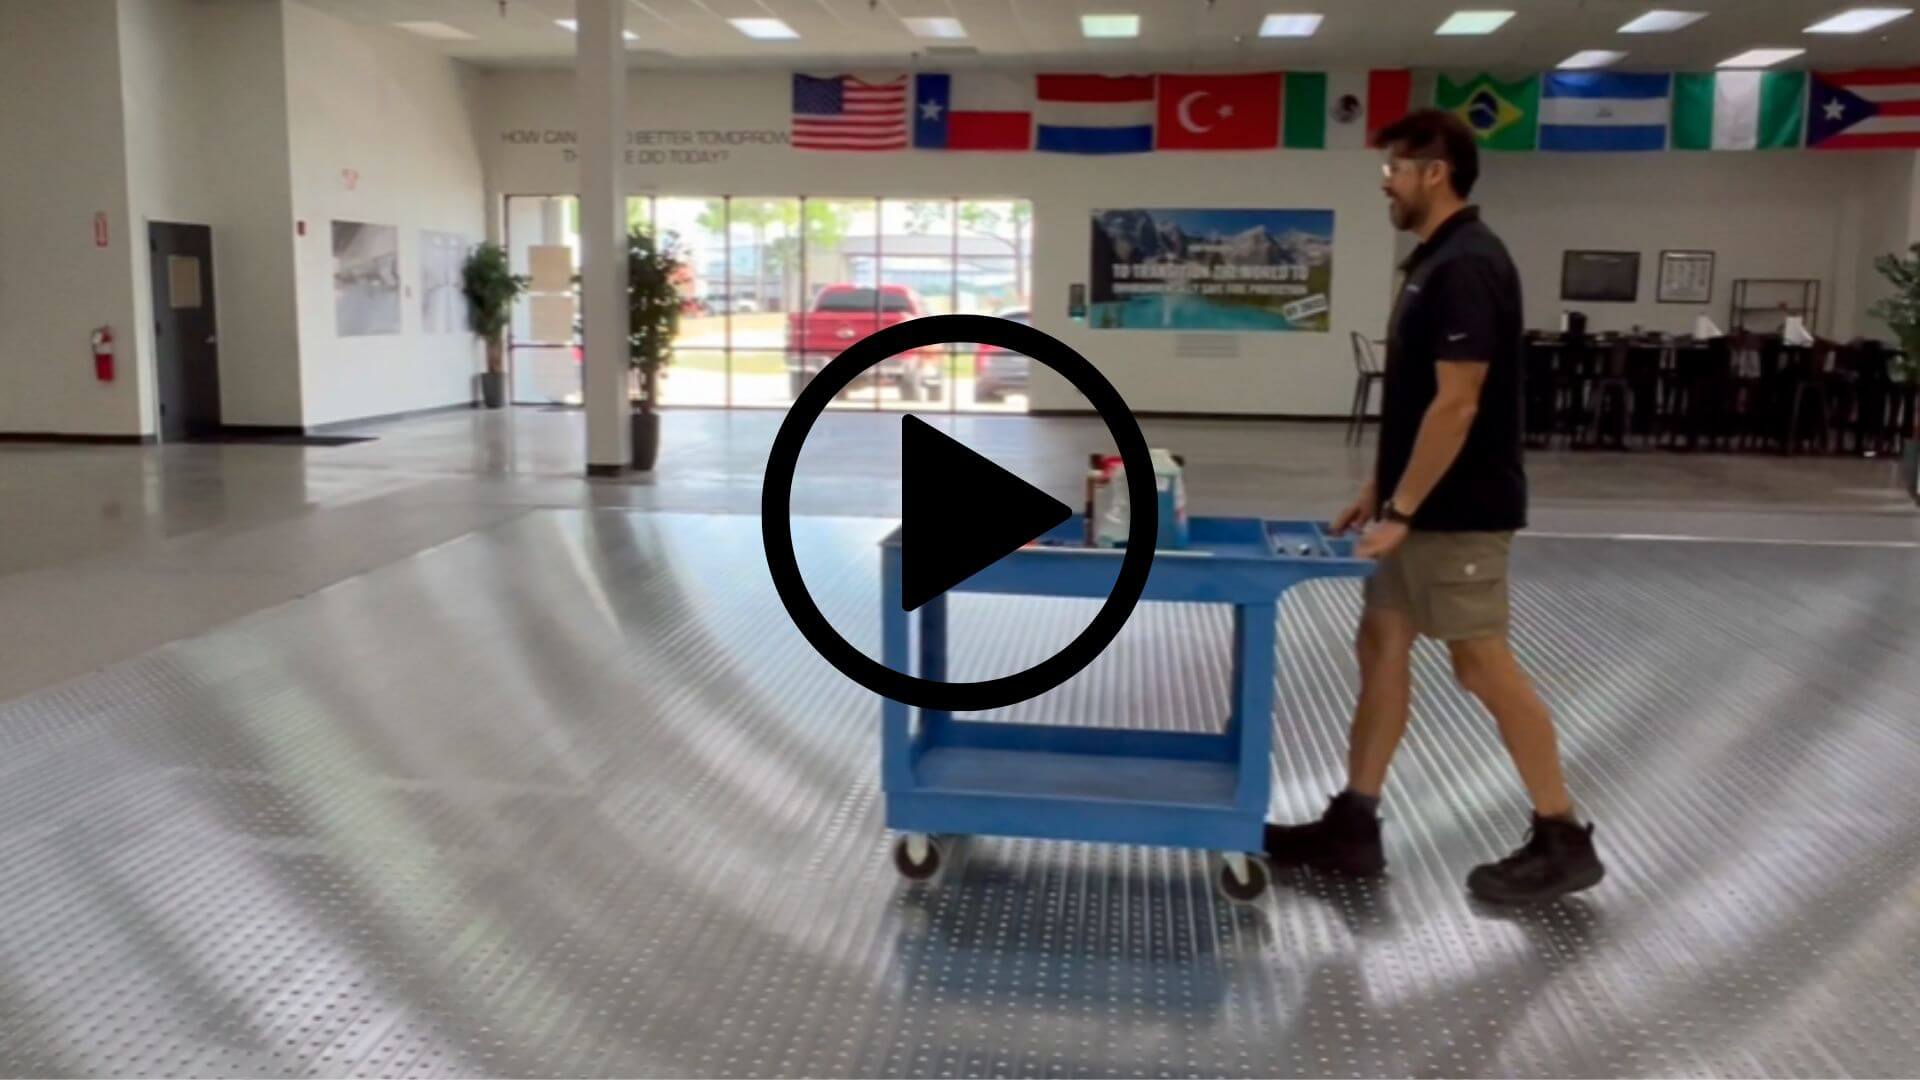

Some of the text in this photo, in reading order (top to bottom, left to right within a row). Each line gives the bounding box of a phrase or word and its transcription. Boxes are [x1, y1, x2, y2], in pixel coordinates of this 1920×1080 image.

[501, 130, 539, 144] HOW
[543, 130, 578, 144] CAN
[635, 130, 692, 145] BETTER
[669, 149, 730, 164] TODAY?
[1112, 263, 1130, 279] TO
